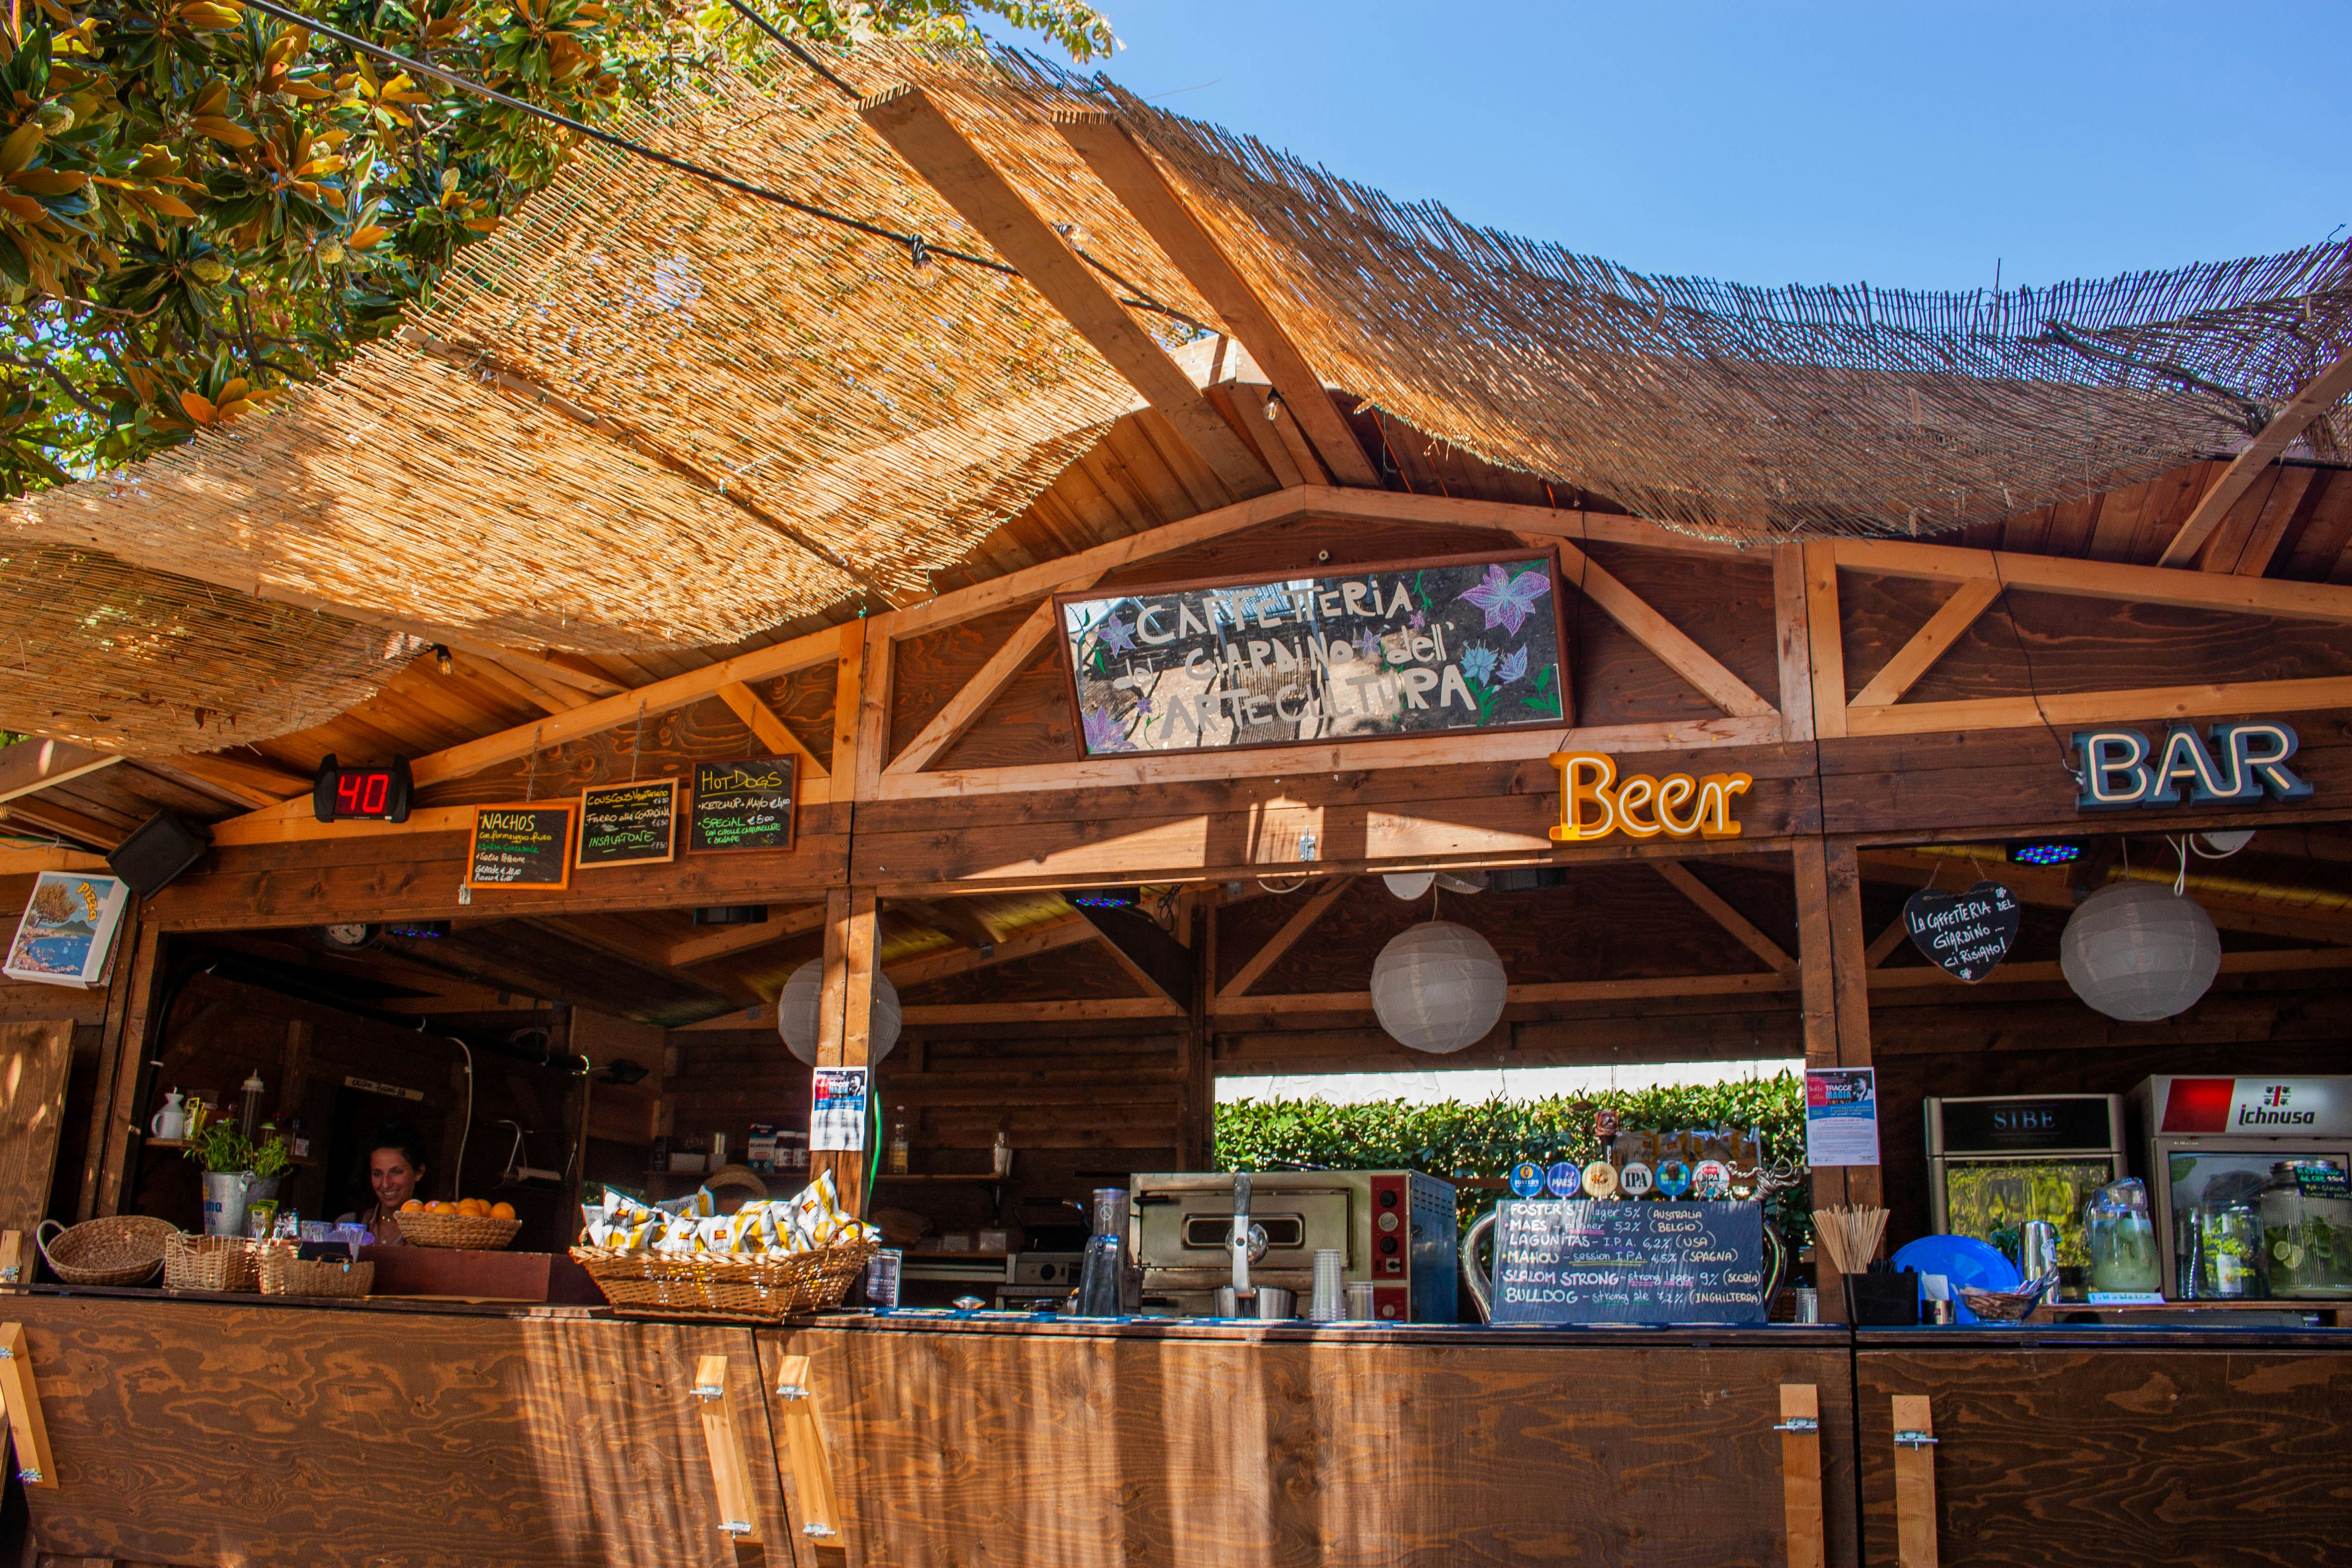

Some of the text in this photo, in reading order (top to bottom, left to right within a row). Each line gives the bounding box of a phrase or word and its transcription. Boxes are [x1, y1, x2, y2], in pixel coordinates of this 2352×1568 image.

[1159, 664, 1477, 739] ARTECULTURA
[2070, 720, 2314, 812] BAR
[730, 770, 782, 789] DOGS
[338, 774, 389, 813] 40
[1548, 751, 1753, 841] Beer
[745, 797, 769, 811] MAYO
[481, 812, 536, 832] NACHOS
[589, 830, 658, 848] INSALATONE
[1911, 898, 2016, 934] LA CAFFETTERIA DEL
[1825, 1091, 1852, 1099] MAGIA
[1993, 1110, 2056, 1129] SIBE
[1624, 1172, 1648, 1187] IPA
[1510, 1203, 1574, 1217] FOSTER'S
[1623, 1206, 1641, 1220] 5%
[1510, 1219, 1548, 1232] MAES
[1565, 1219, 1605, 1233] pilsner
[1613, 1221, 1641, 1234] 5,2%
[1642, 1237, 1672, 1251] 6,2%
[1675, 1230, 1716, 1249] (USA)
[1507, 1250, 1560, 1264] MAHOU
[1573, 1250, 1611, 1262] session
[1682, 1247, 1738, 1263] (SPAGNA)
[1502, 1269, 1557, 1285] SLALOM
[1560, 1271, 1619, 1286] STRONG
[1628, 1271, 1661, 1286] strong
[1666, 1270, 1695, 1286] lager
[1699, 1272, 1719, 1286] 9%
[1504, 1287, 1578, 1304] BULLDOG
[1591, 1289, 1629, 1305] strong
[1633, 1289, 1650, 1301] ale
